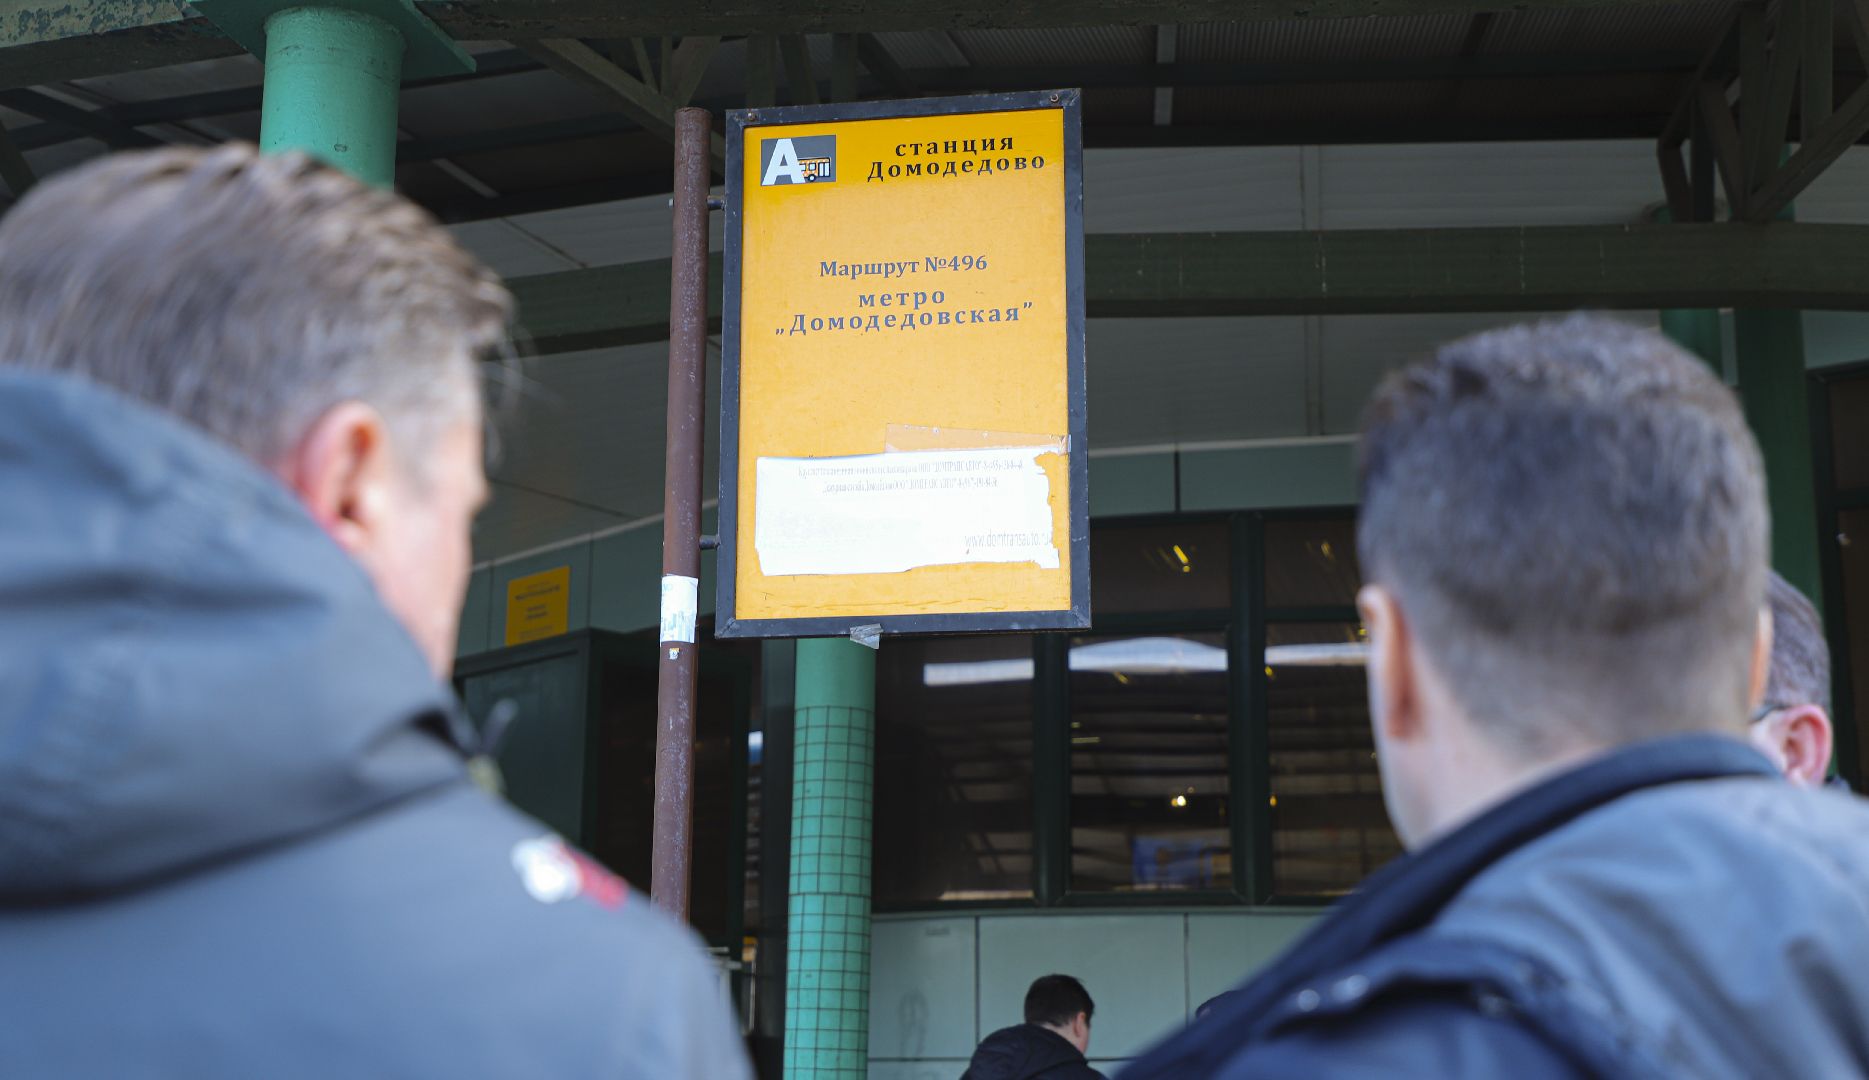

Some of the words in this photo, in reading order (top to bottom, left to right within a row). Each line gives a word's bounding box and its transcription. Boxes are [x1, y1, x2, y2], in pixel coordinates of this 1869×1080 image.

[895, 135, 1014, 157] станция
[867, 154, 1045, 182] Домодедово
[819, 258, 919, 280] Маршрут
[925, 255, 988, 273] №496
[859, 290, 946, 311] метро
